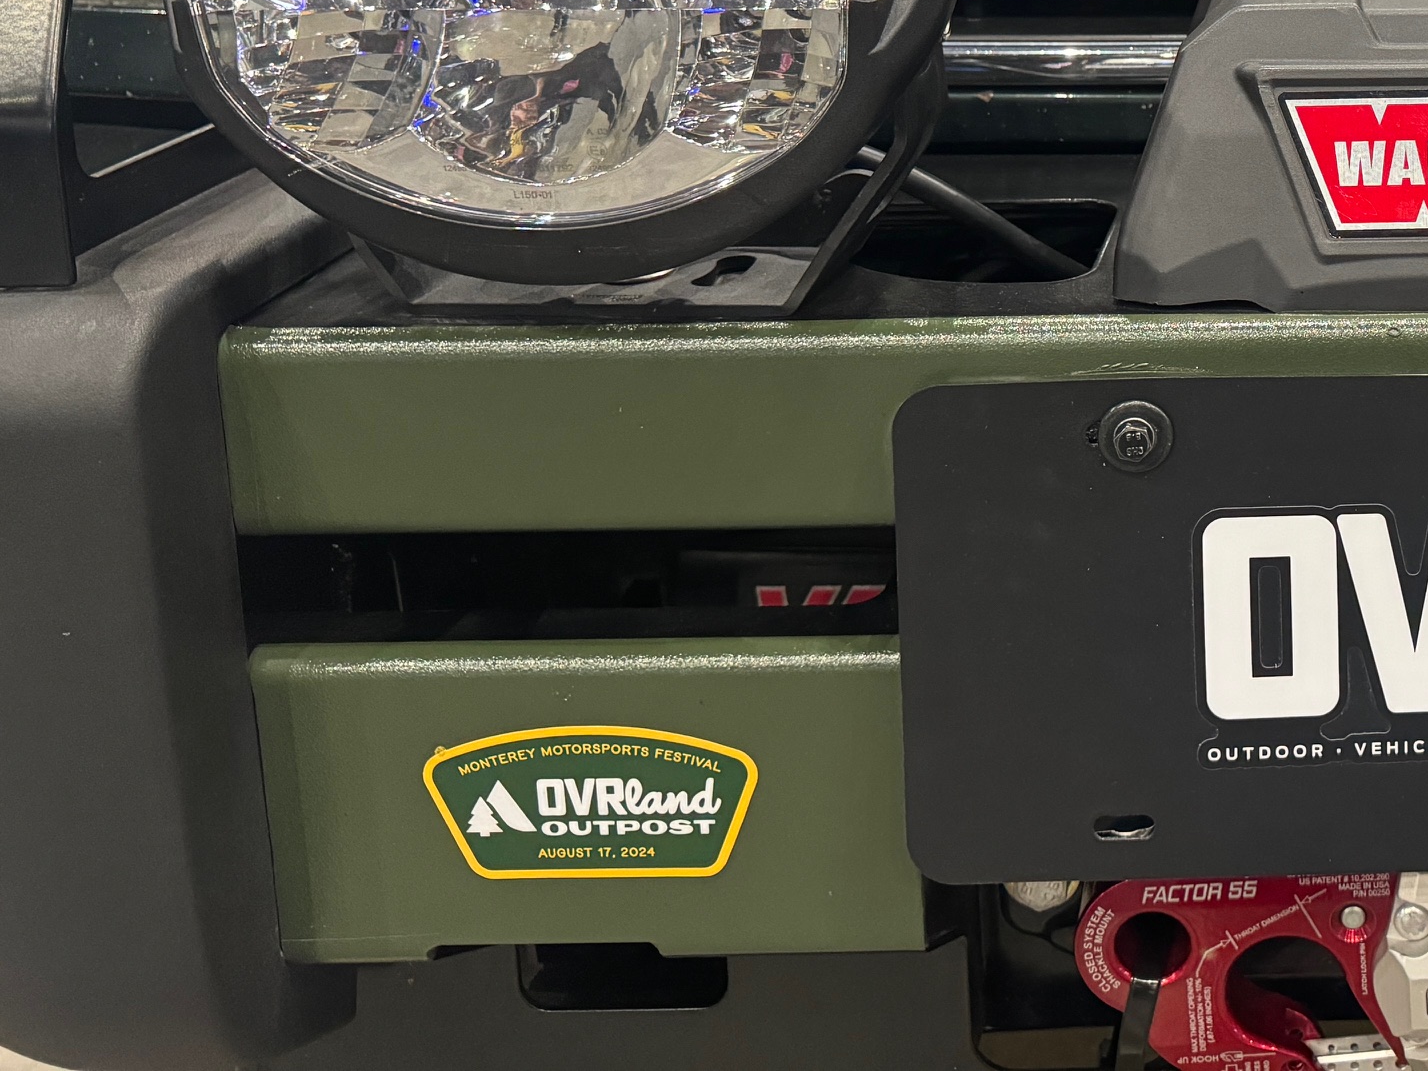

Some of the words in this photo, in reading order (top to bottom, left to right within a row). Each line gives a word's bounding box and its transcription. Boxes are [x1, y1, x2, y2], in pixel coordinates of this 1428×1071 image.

[457, 747, 535, 776] MONTEREY
[541, 743, 649, 758] MOTORSPORTS
[654, 748, 722, 773] FESTIVAL
[1207, 743, 1325, 762] OUTDOOR
[536, 777, 722, 817] OVRland
[541, 819, 716, 837] OUTPOST
[537, 847, 593, 859] AUGUST
[597, 847, 616, 859] 17,
[621, 846, 656, 858] 2024
[1142, 882, 1222, 904] FACTOR
[1228, 880, 1258, 900] 55
[1298, 876, 1310, 885] US
[1312, 875, 1341, 885] PATENT
[1373, 881, 1390, 889] USA
[1083, 906, 1106, 949] SYSTEM
[1094, 909, 1115, 944] MOUNT
[1234, 922, 1261, 941] THROAT
[1261, 903, 1300, 928] DIMENSION
[1084, 953, 1111, 993] CLOSED
[1093, 946, 1121, 989] SHACKLE
[1186, 977, 1195, 1009] OPENING
[1188, 1010, 1197, 1037] THROAT
[1177, 1056, 1189, 1064] UP
[1190, 1055, 1219, 1064] HOOK
